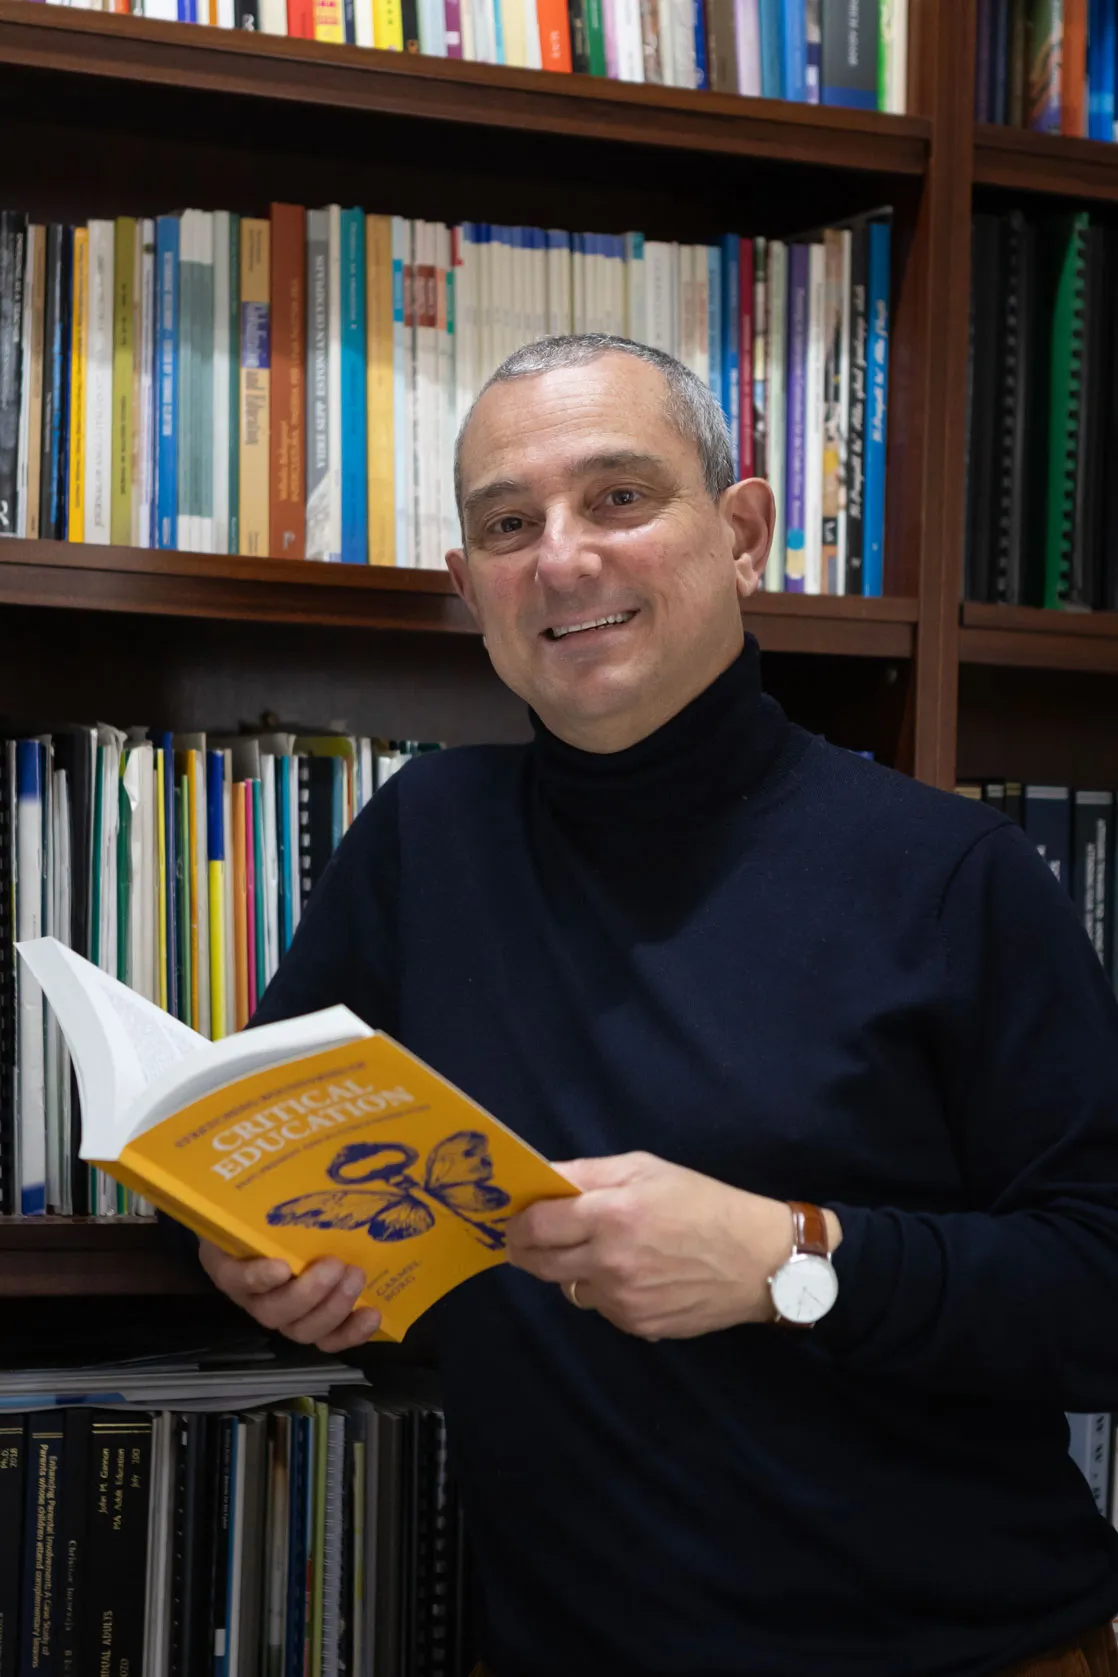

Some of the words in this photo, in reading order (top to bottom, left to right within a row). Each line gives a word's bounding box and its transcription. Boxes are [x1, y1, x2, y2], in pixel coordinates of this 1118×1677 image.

[211, 1078, 374, 1153] CRITICAL
[210, 1086, 415, 1181] EDUCATION
[38, 1444, 49, 1476] Parents
[114, 1447, 126, 1485] Education
[38, 1477, 47, 1505] whose
[46, 1455, 58, 1499] Enhancing
[45, 1500, 56, 1536] Parental
[98, 1495, 109, 1514] John
[36, 1506, 47, 1541] children
[35, 1542, 46, 1570] attend
[32, 1570, 44, 1637] complementary
[43, 1599, 52, 1620] Case
[41, 1620, 50, 1645] Study
[101, 1609, 113, 1646] ADULTS
[32, 1638, 42, 1668] lessons
[41, 1646, 50, 1656] of
